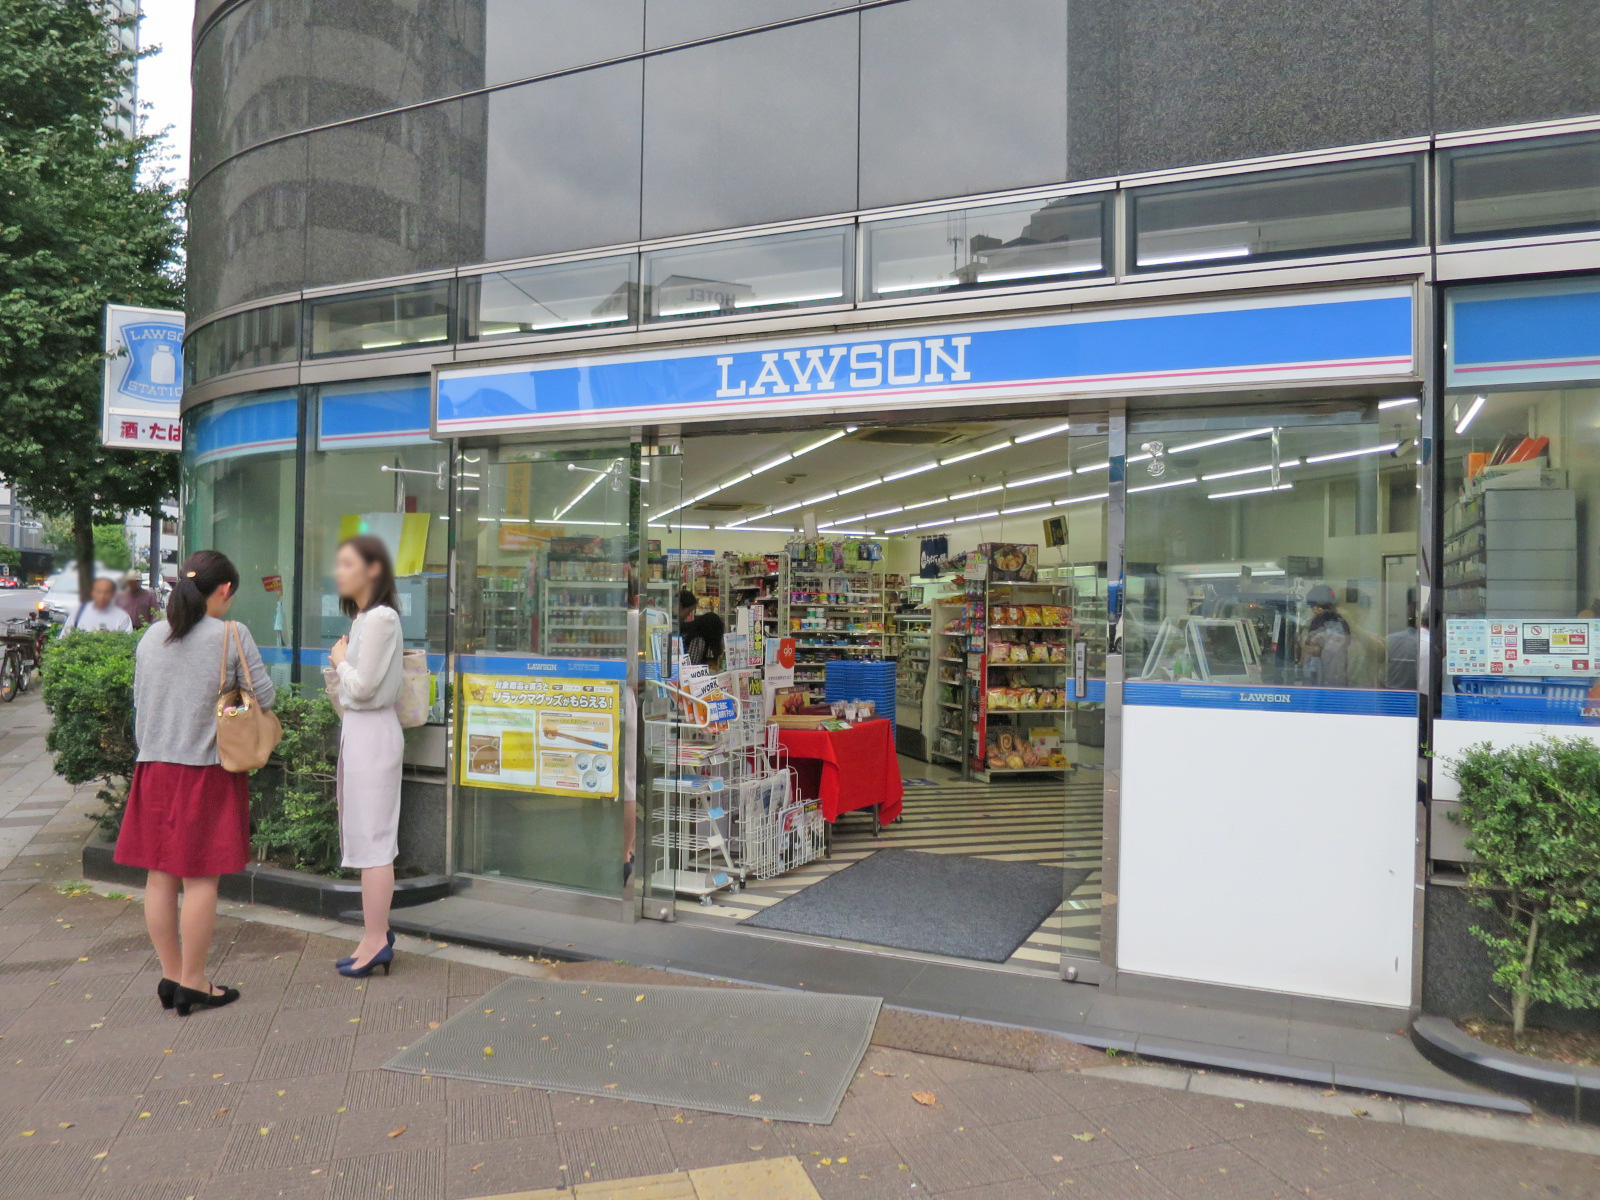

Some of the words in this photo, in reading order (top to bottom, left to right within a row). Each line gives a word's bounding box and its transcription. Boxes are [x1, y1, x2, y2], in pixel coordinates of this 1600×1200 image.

[716, 336, 972, 398] LAWSON
[526, 663, 558, 671] LAWSON
[690, 668, 710, 679] WORK
[701, 680, 719, 695] WORK
[1239, 693, 1291, 703] LAWSON
